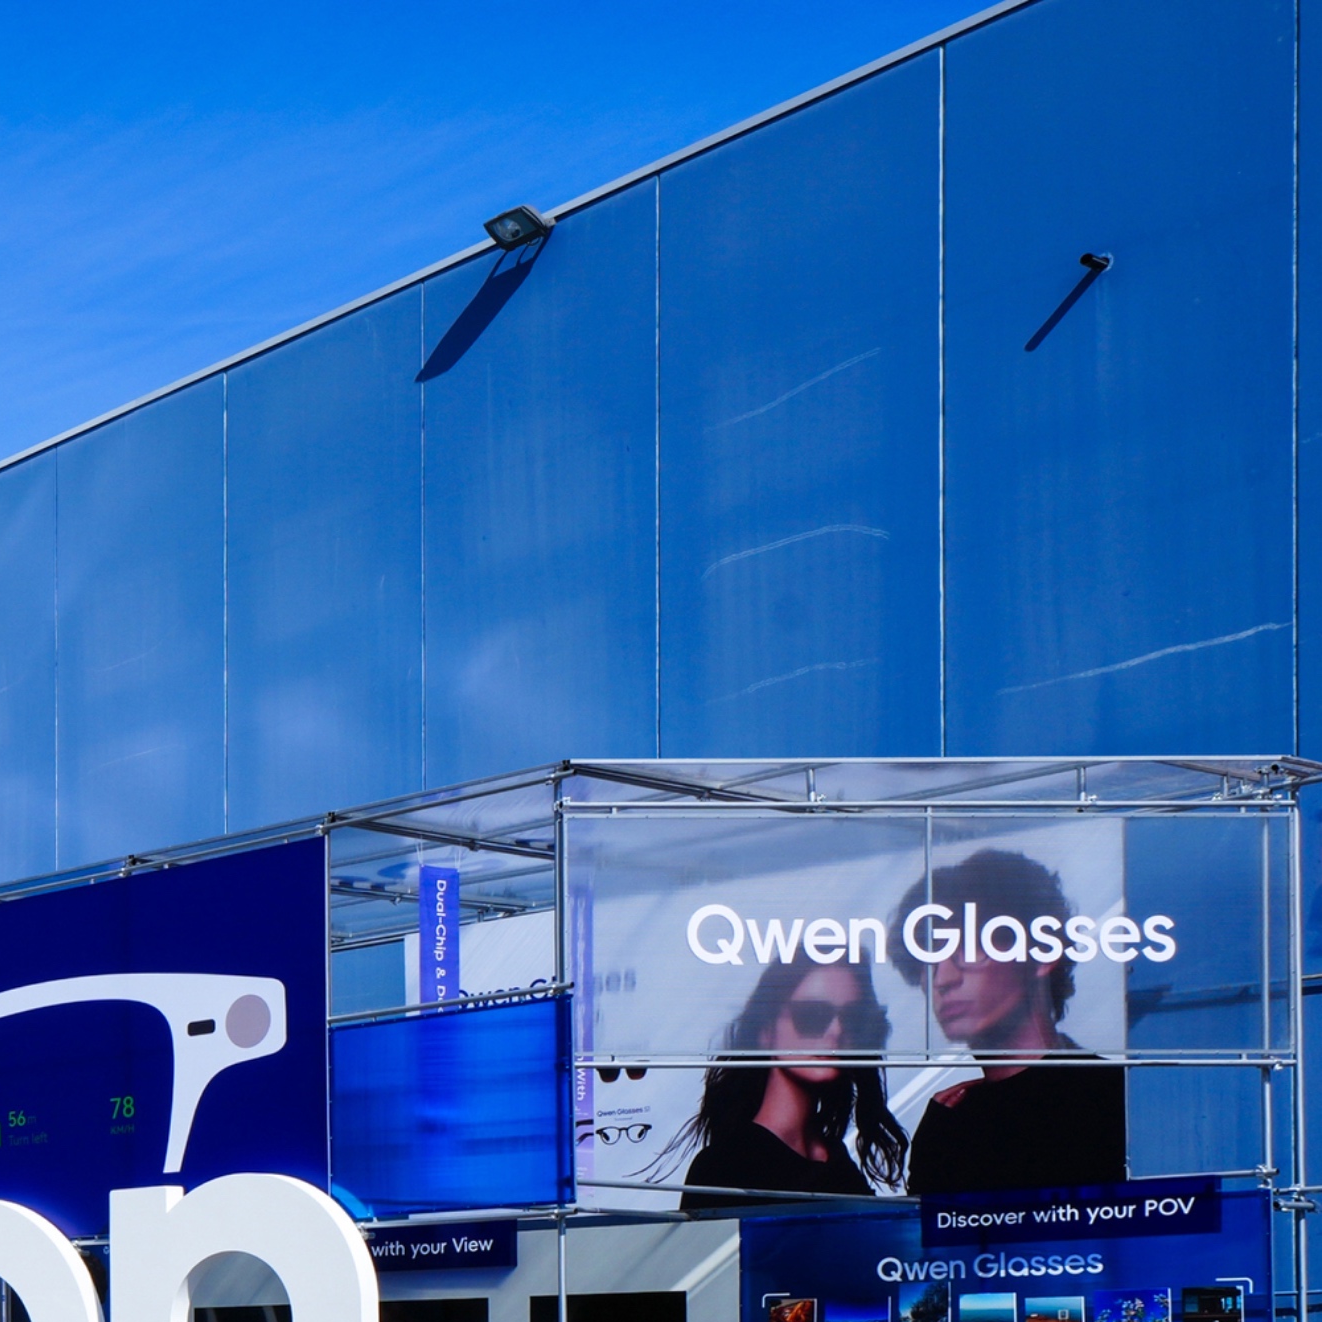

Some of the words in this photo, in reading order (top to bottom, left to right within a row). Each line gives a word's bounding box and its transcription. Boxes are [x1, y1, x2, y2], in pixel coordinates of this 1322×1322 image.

[434, 879, 447, 961] Dual-Chip
[687, 904, 887, 965] Qwen
[902, 902, 1177, 963] Glasses
[435, 967, 447, 979] &
[8, 1111, 27, 1127] 56
[109, 1096, 135, 1119] 78
[9, 1134, 29, 1146] Turn
[31, 1130, 49, 1144] left
[937, 1211, 1026, 1229] Discover
[1033, 1204, 1079, 1223] with
[1086, 1203, 1136, 1224] your
[1144, 1197, 1195, 1217] POV
[371, 1241, 405, 1257] with
[410, 1241, 447, 1259] your
[452, 1237, 494, 1253] View
[877, 1256, 966, 1282] Qwen
[973, 1252, 1105, 1278] Glasses
